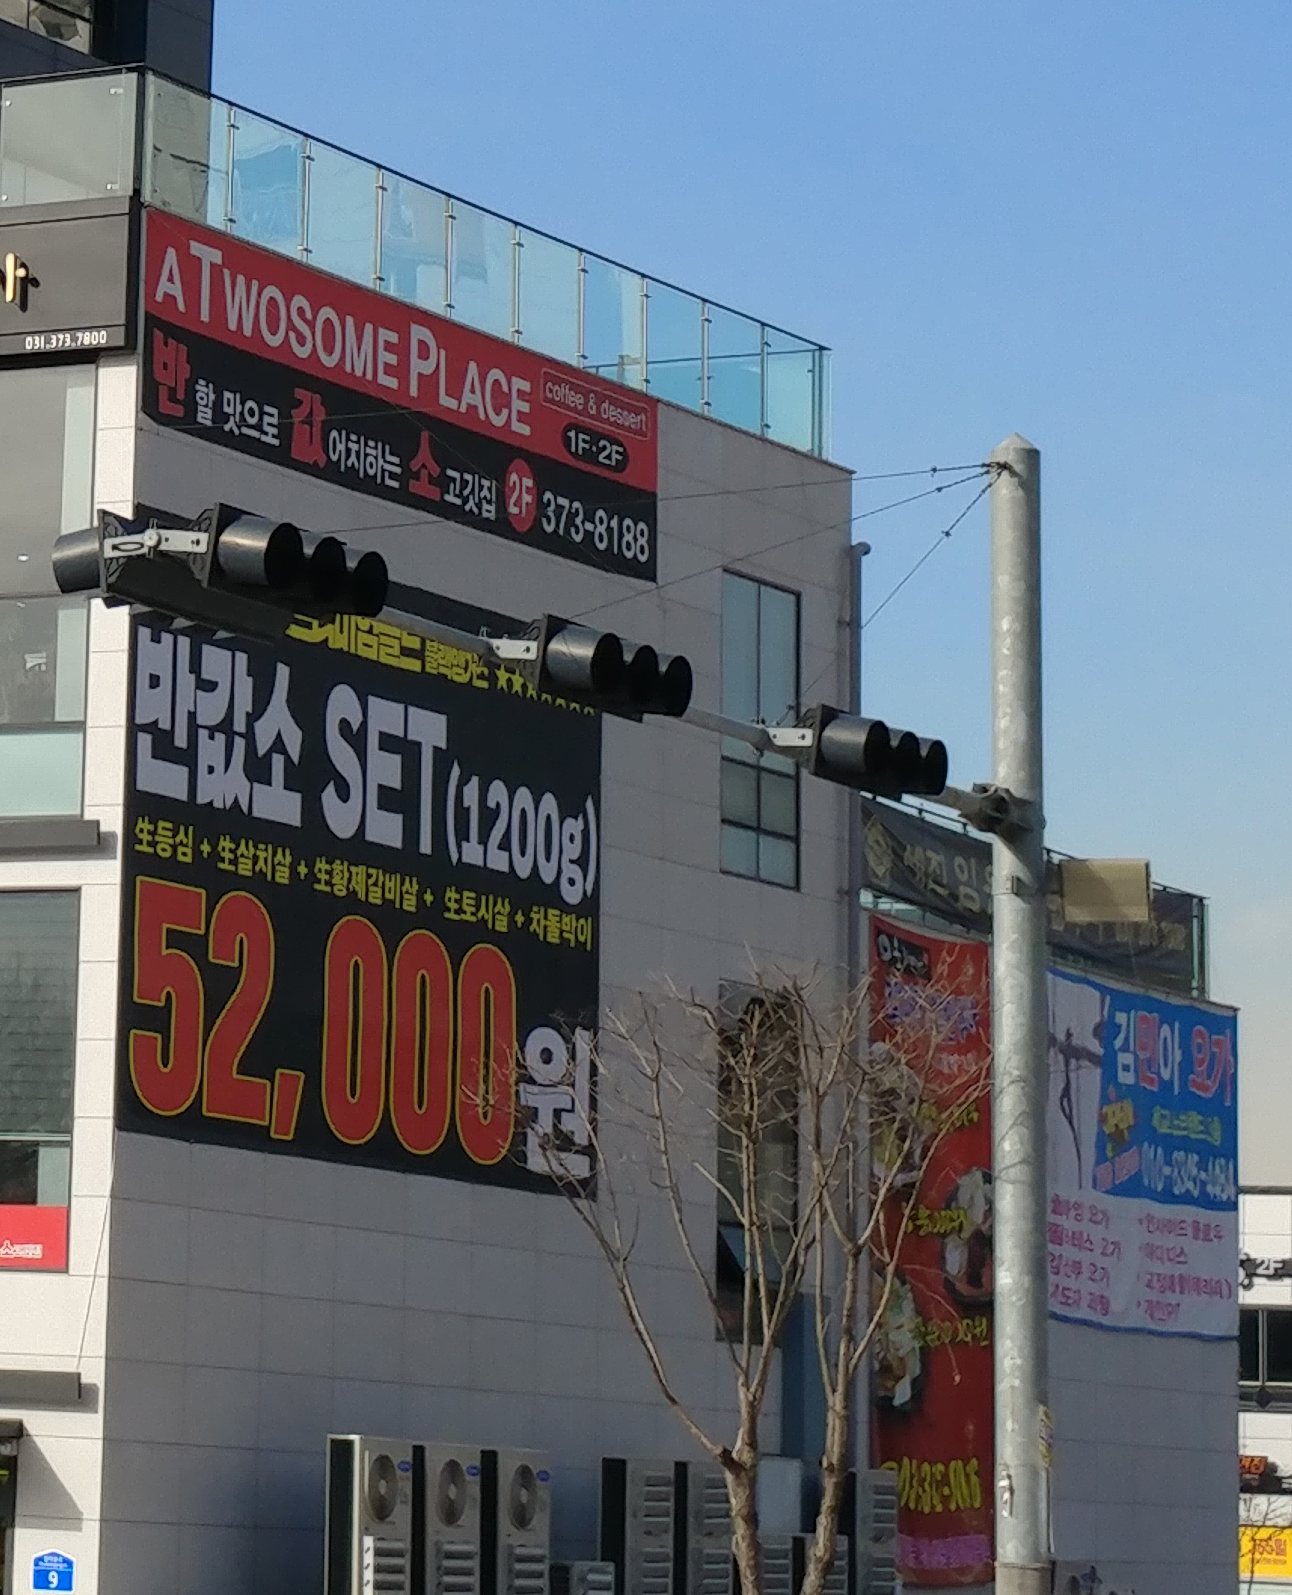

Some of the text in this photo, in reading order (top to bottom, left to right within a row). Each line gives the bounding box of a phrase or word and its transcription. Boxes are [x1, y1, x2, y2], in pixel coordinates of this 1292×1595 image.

[154, 239, 532, 437] A TWOSOME PLACE
[544, 379, 584, 412] coffee
[600, 400, 648, 433] dessert
[222, 389, 650, 564] 맛으로 2F 373-8188
[134, 624, 597, 906] 반값소 SET (1200g)
[529, 906, 593, 953] 차돌박이
[1113, 1009, 1234, 1106] 김민아 요가
[1256, 1259, 1283, 1275] 2F
[47, 1571, 59, 1589] 9
